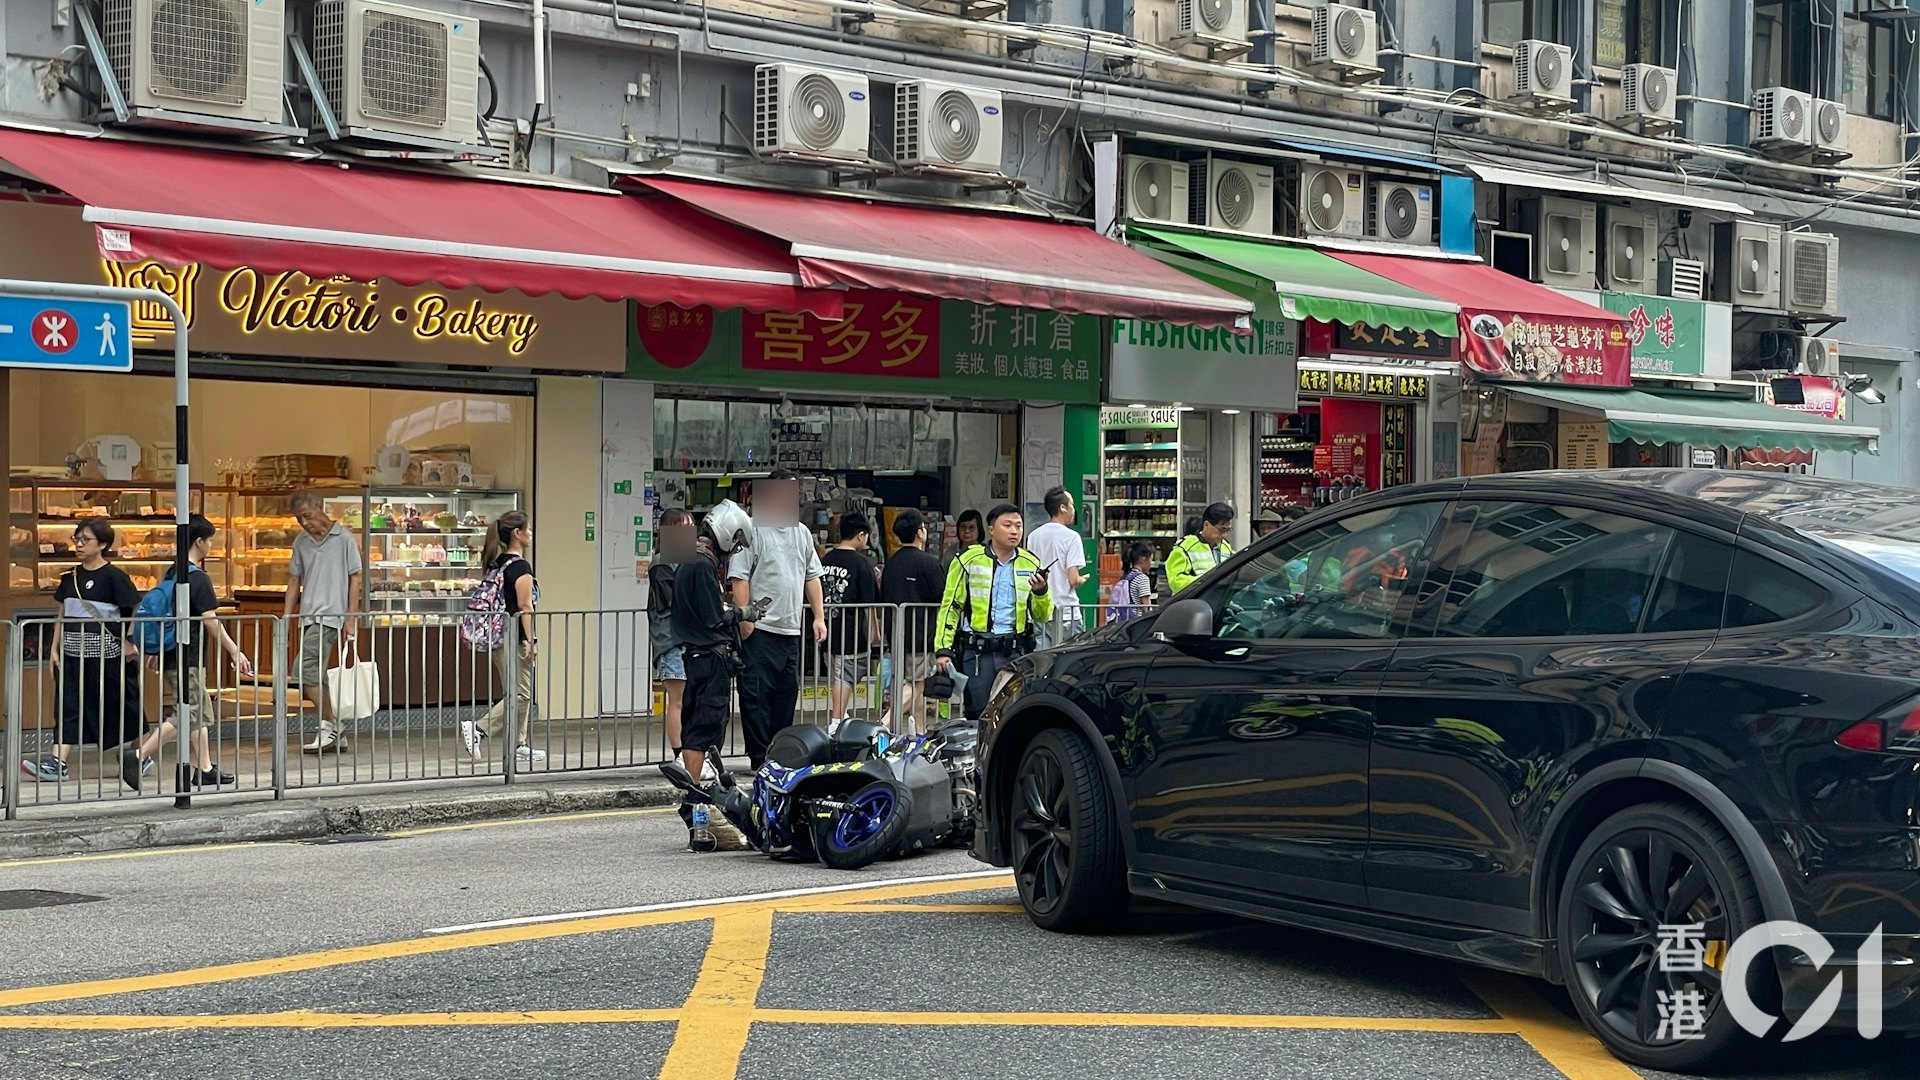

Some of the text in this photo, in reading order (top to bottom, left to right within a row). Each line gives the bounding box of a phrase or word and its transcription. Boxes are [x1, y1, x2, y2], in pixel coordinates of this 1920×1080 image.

[222, 265, 538, 353] Victori Bakery
[755, 300, 929, 368] 喜多多
[970, 305, 1075, 351] 折扣倉
[1265, 320, 1285, 337] 環保
[1264, 340, 1294, 356] 折扣店
[1061, 358, 1089, 380] 食品
[1108, 411, 1132, 425] SAVE
[1151, 410, 1175, 424] SAVE
